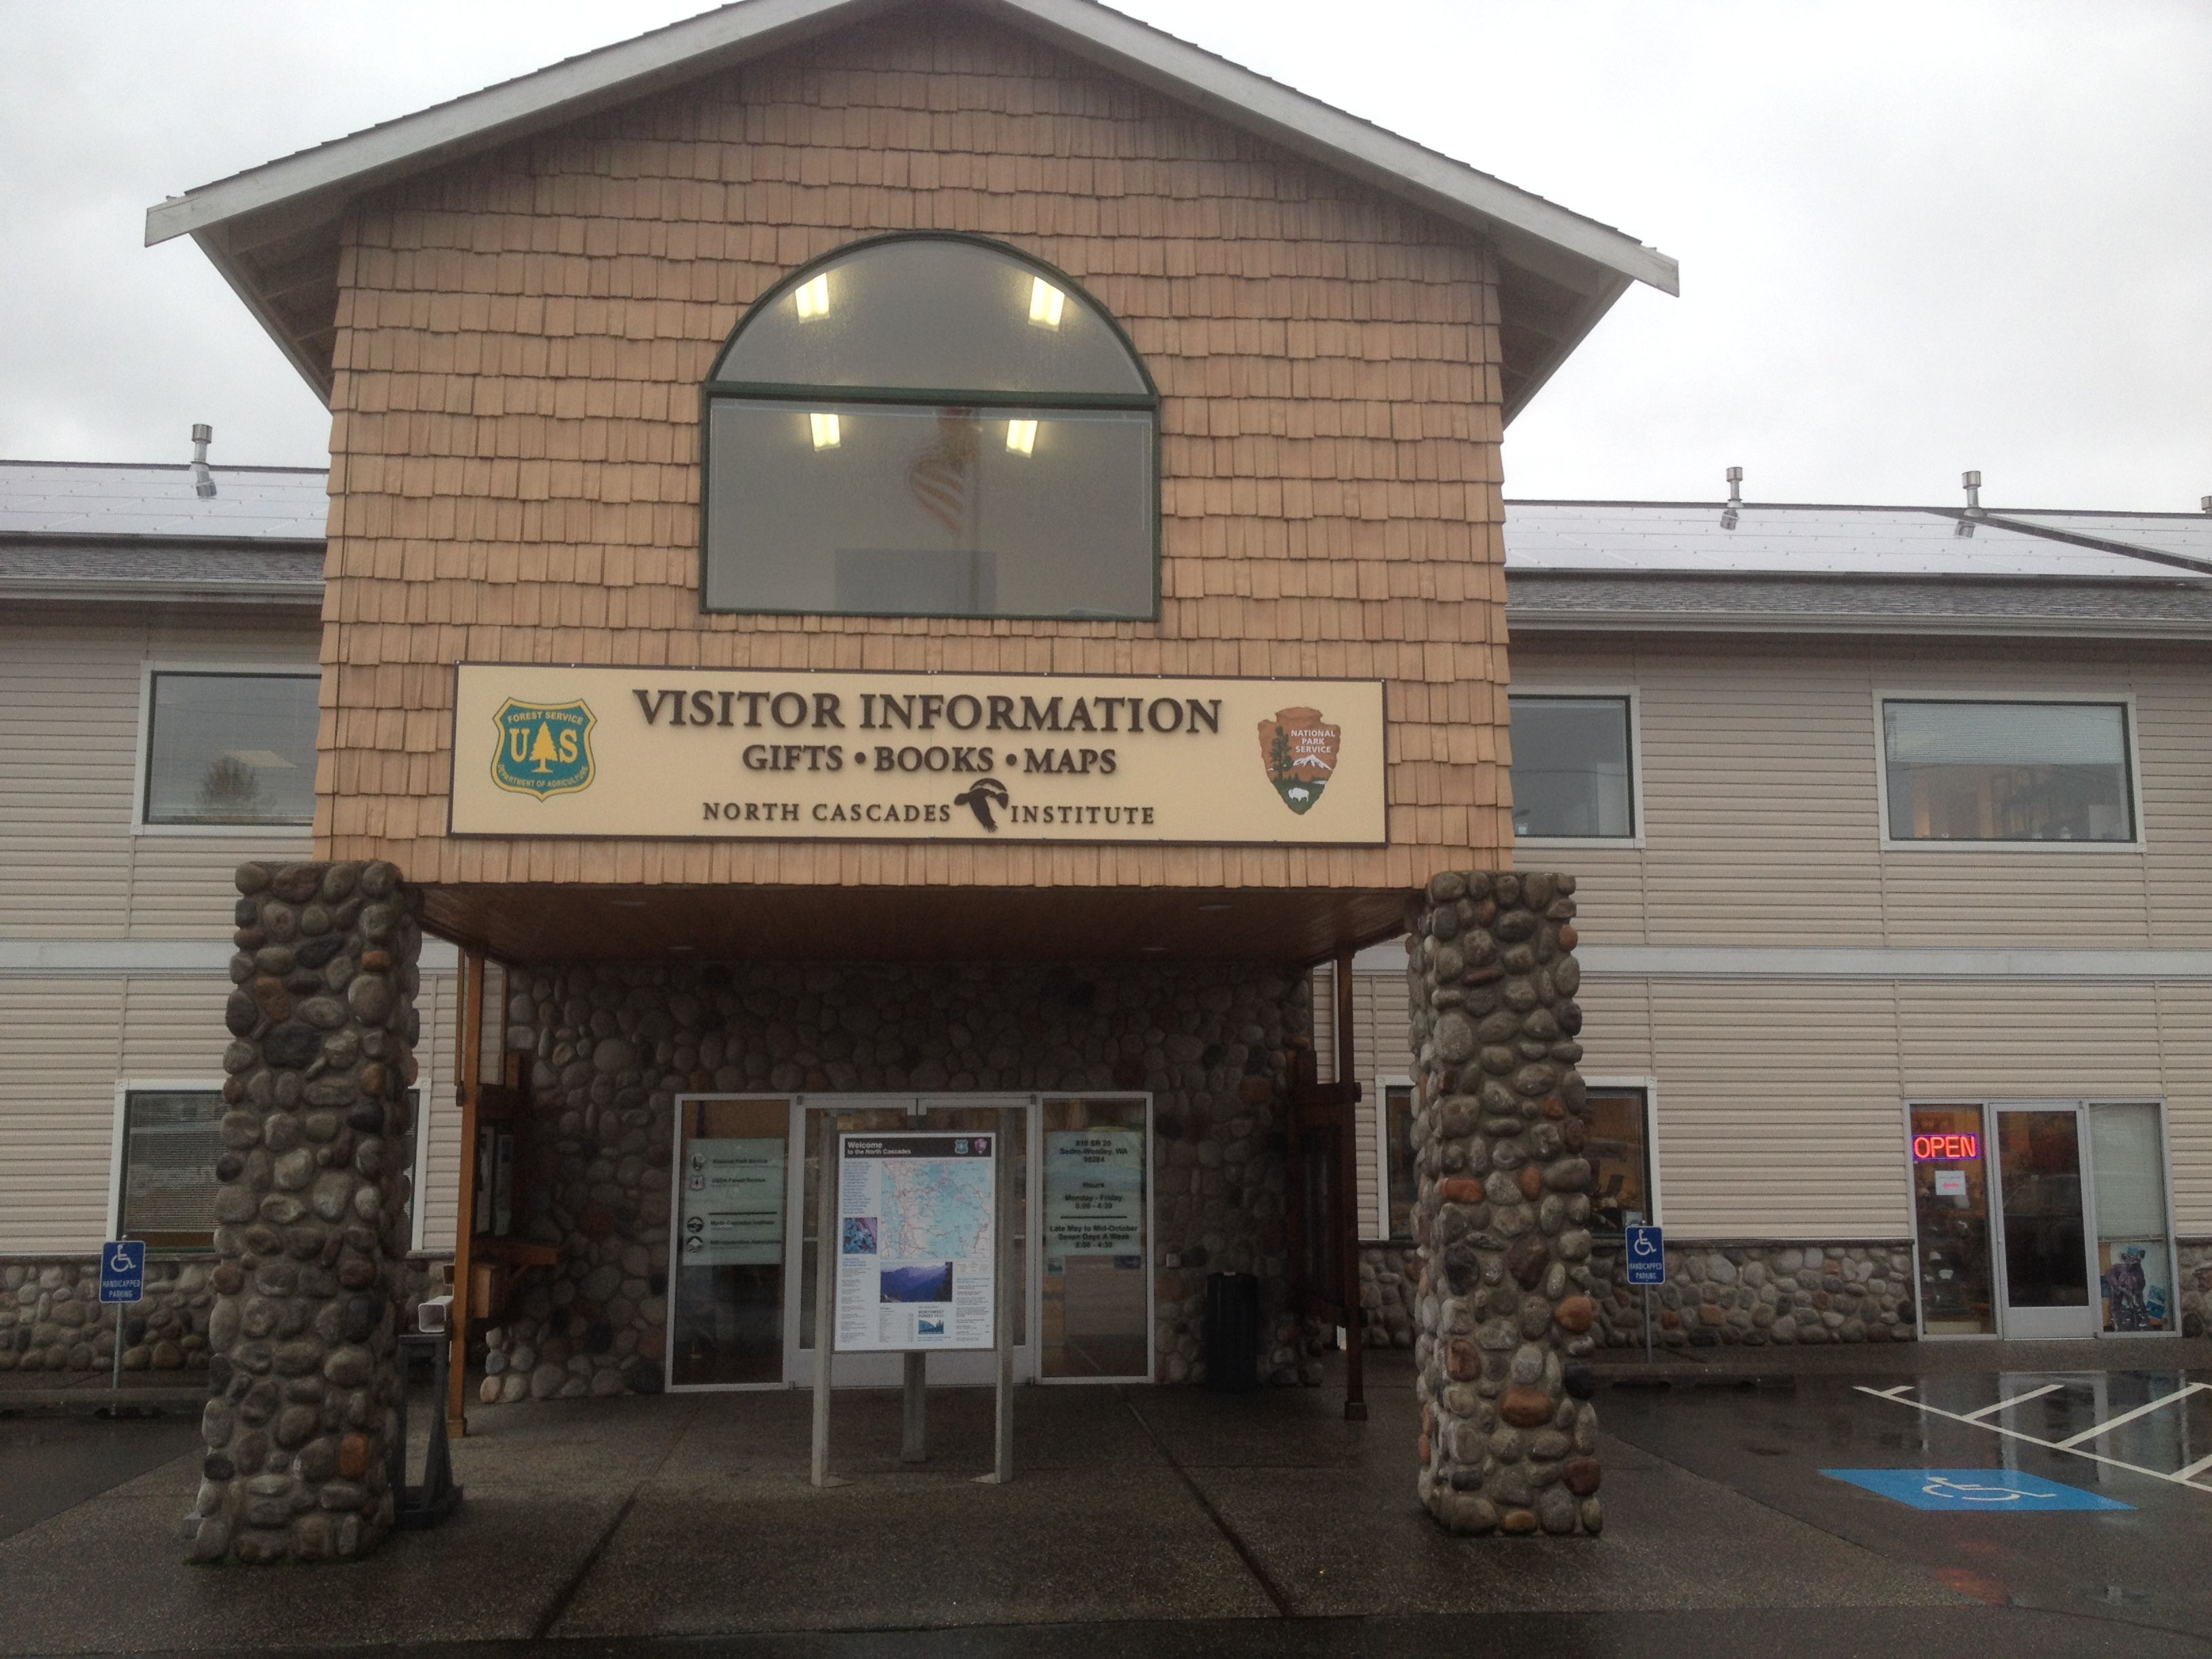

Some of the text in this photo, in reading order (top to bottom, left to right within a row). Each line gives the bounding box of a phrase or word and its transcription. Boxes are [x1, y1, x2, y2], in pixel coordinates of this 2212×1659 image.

[507, 711, 583, 725] FOREST SERVICE
[633, 689, 1223, 735] VISITOR INFORMATION
[742, 744, 1117, 775] GIFTS BOOKS MAPS
[497, 764, 534, 787] DEPARTMENT
[547, 765, 588, 787] AGRICULTURE
[703, 802, 1155, 824] NORTH CASCADES INSTITUTE
[847, 1141, 883, 1149] Welcome
[1914, 1135, 1976, 1158] OPEN
[1065, 1194, 1094, 1202] Monday
[1099, 1194, 1123, 1202] Friday
[102, 1279, 141, 1288] HANDICAPPED
[108, 1290, 133, 1298] PARKING
